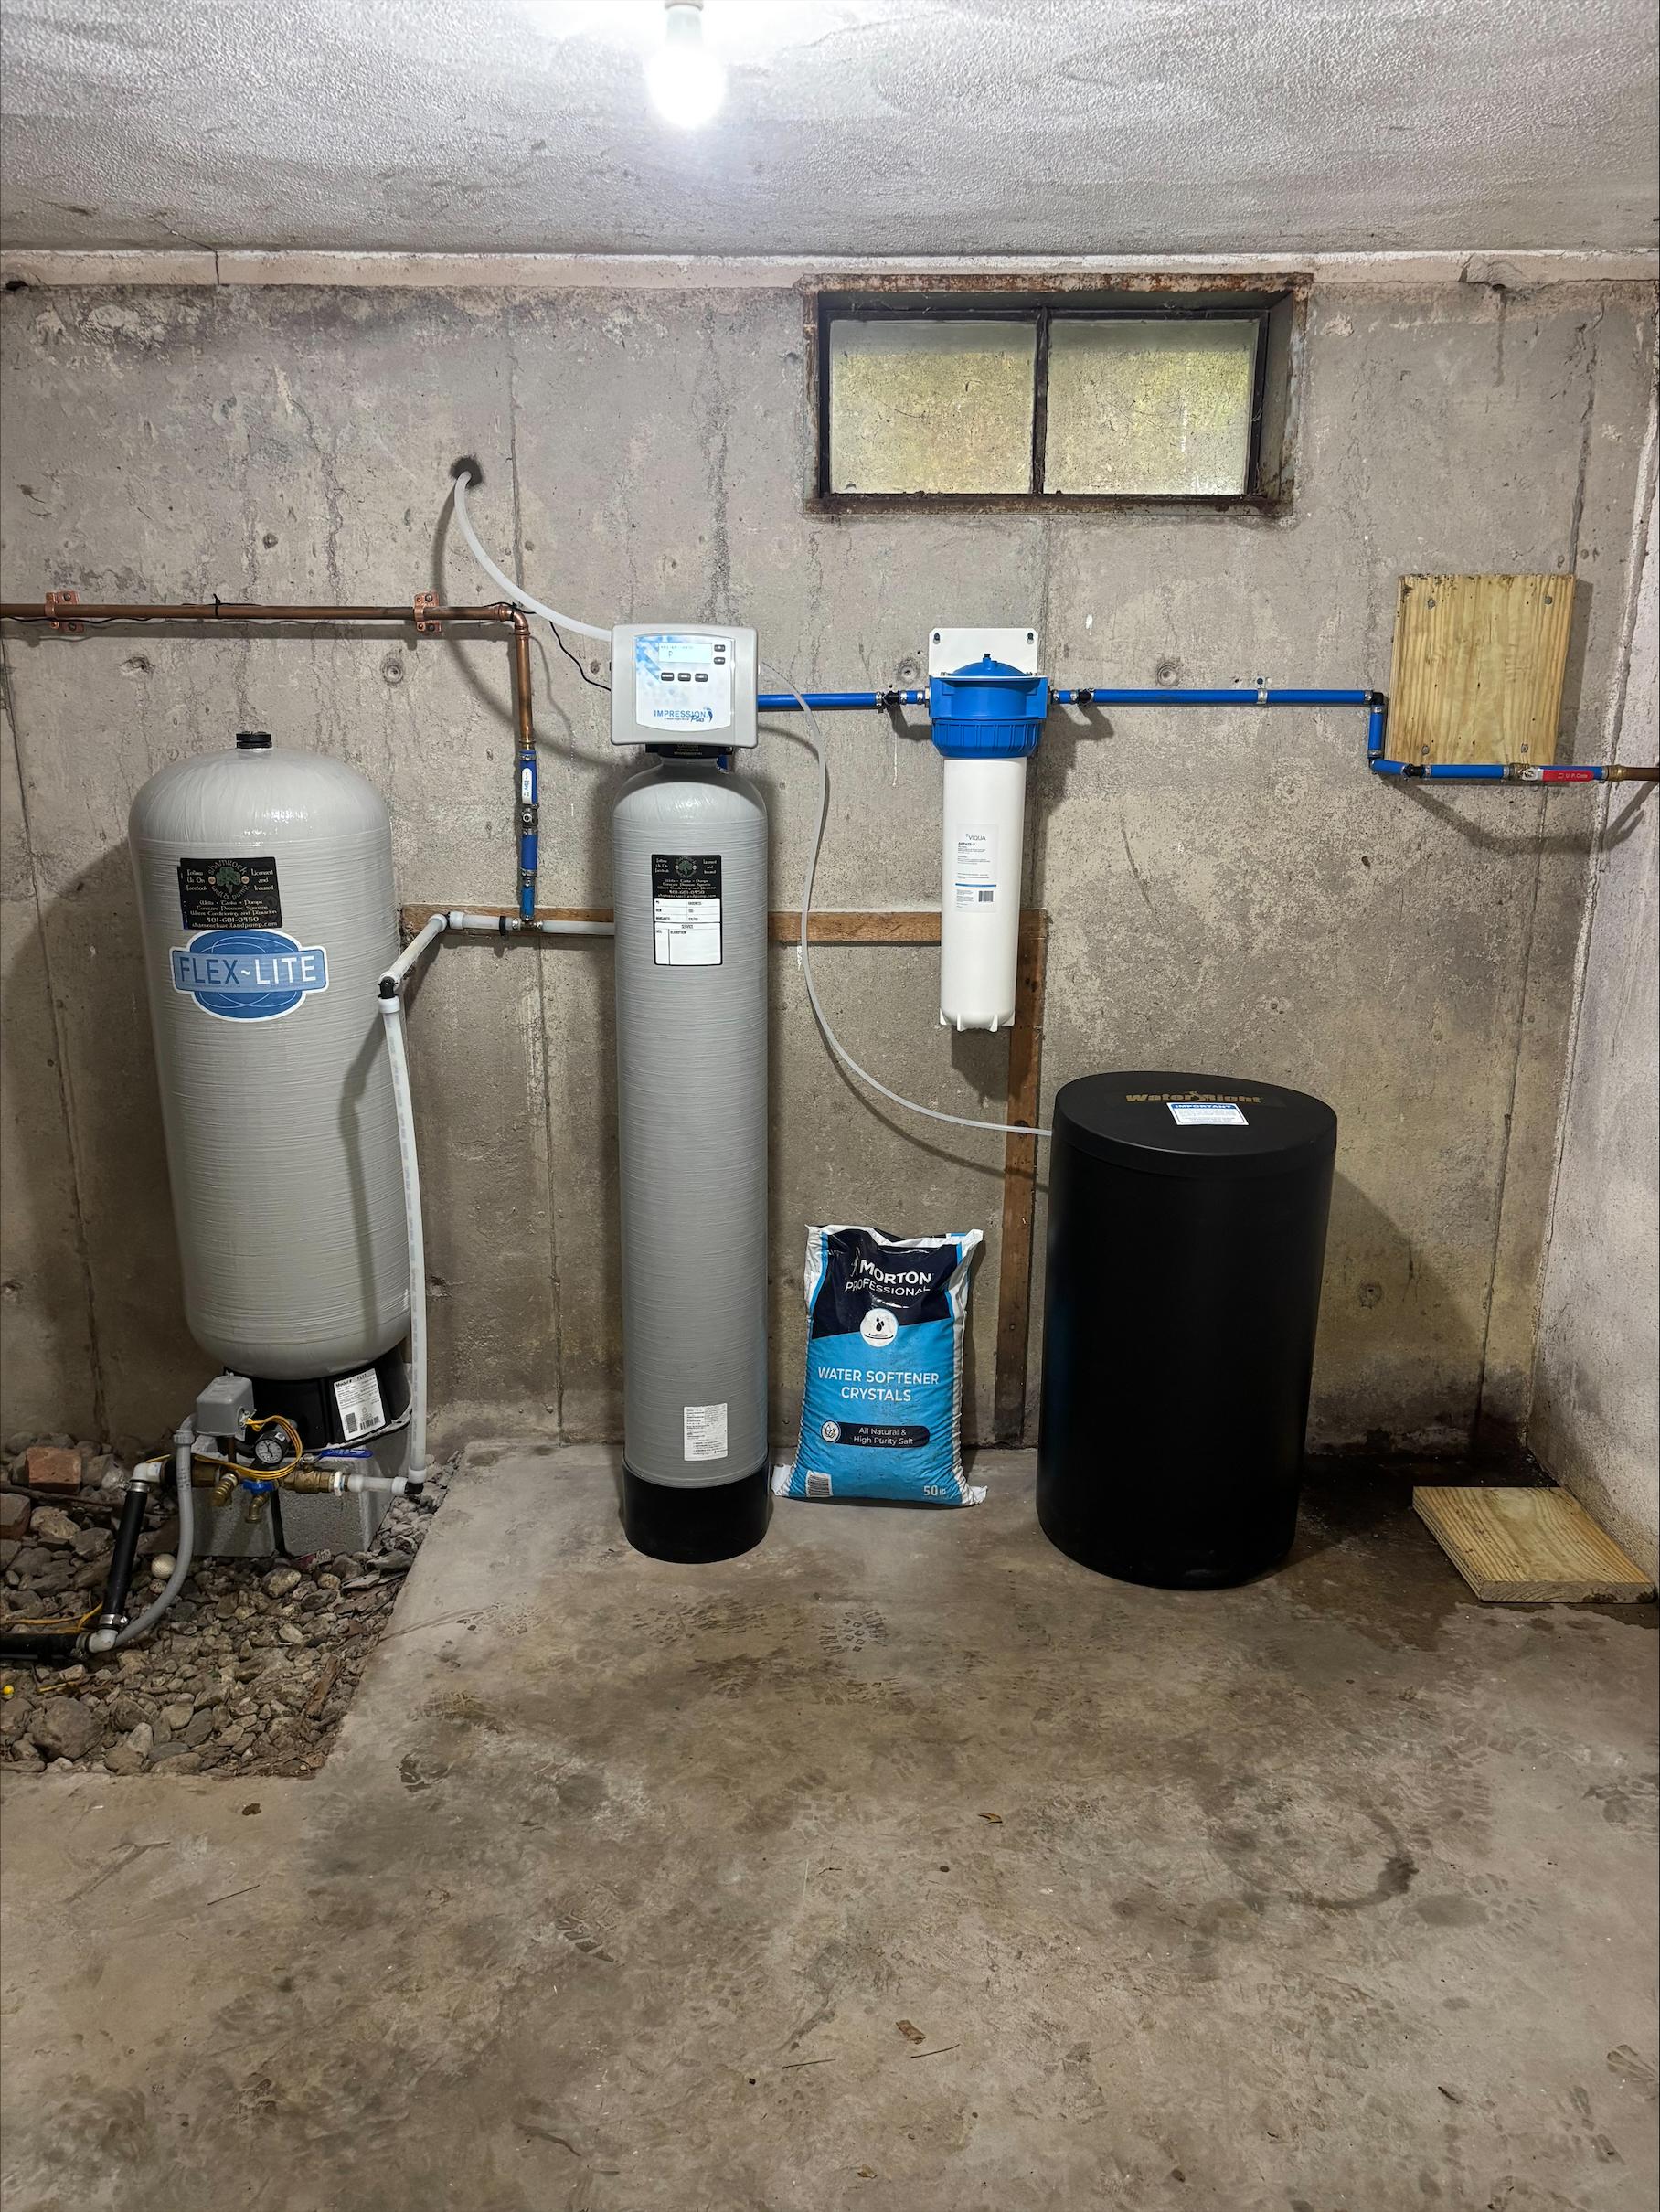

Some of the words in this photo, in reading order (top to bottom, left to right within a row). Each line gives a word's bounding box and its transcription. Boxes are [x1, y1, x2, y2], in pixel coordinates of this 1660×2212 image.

[860, 1260, 932, 1285] MORTON
[845, 1278, 931, 1296] PROFESSIONAL
[818, 1367, 862, 1382] WATER
[866, 1371, 940, 1385] SOFTENER
[841, 1387, 912, 1401] CRYSTALS
[859, 1427, 869, 1435] All
[871, 1428, 899, 1436] Natural
[854, 1435, 872, 1444] High
[874, 1436, 897, 1446] Purity
[899, 1437, 913, 1445] Salt
[923, 1485, 938, 1496] 50
